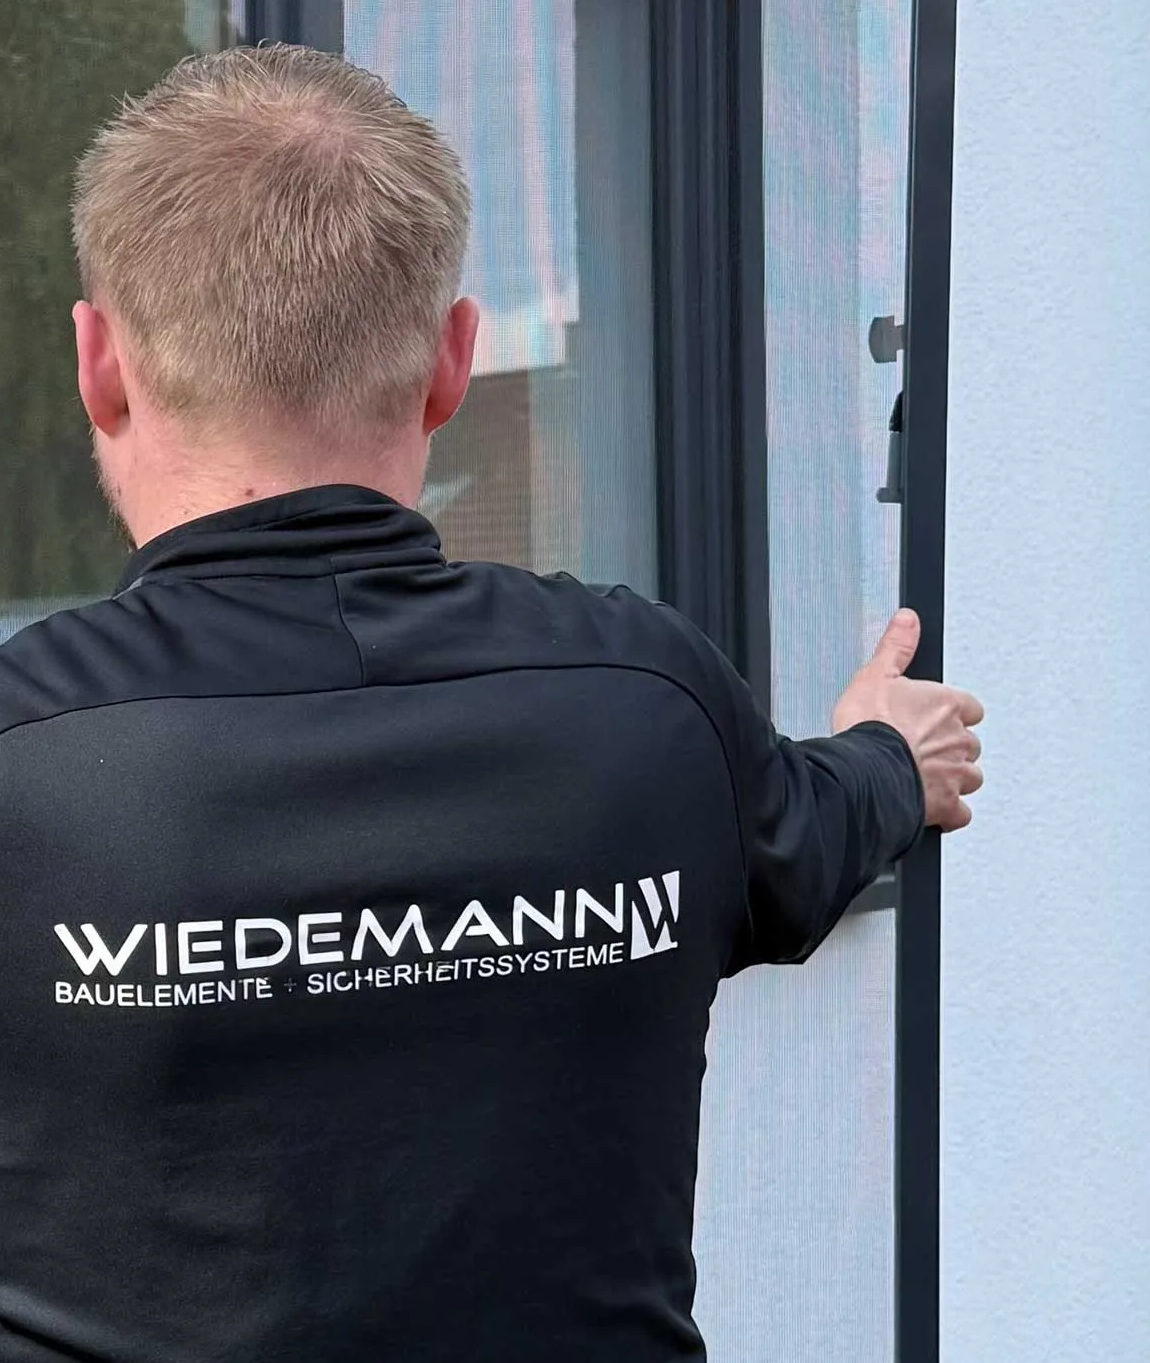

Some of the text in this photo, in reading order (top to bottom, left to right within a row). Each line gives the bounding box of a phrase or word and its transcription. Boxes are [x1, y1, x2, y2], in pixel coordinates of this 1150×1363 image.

[54, 883, 624, 977] WIEDEMANN
[54, 976, 273, 1007] BAUELEMENTE
[306, 941, 625, 995] SICHERHEITSSYSTEME
